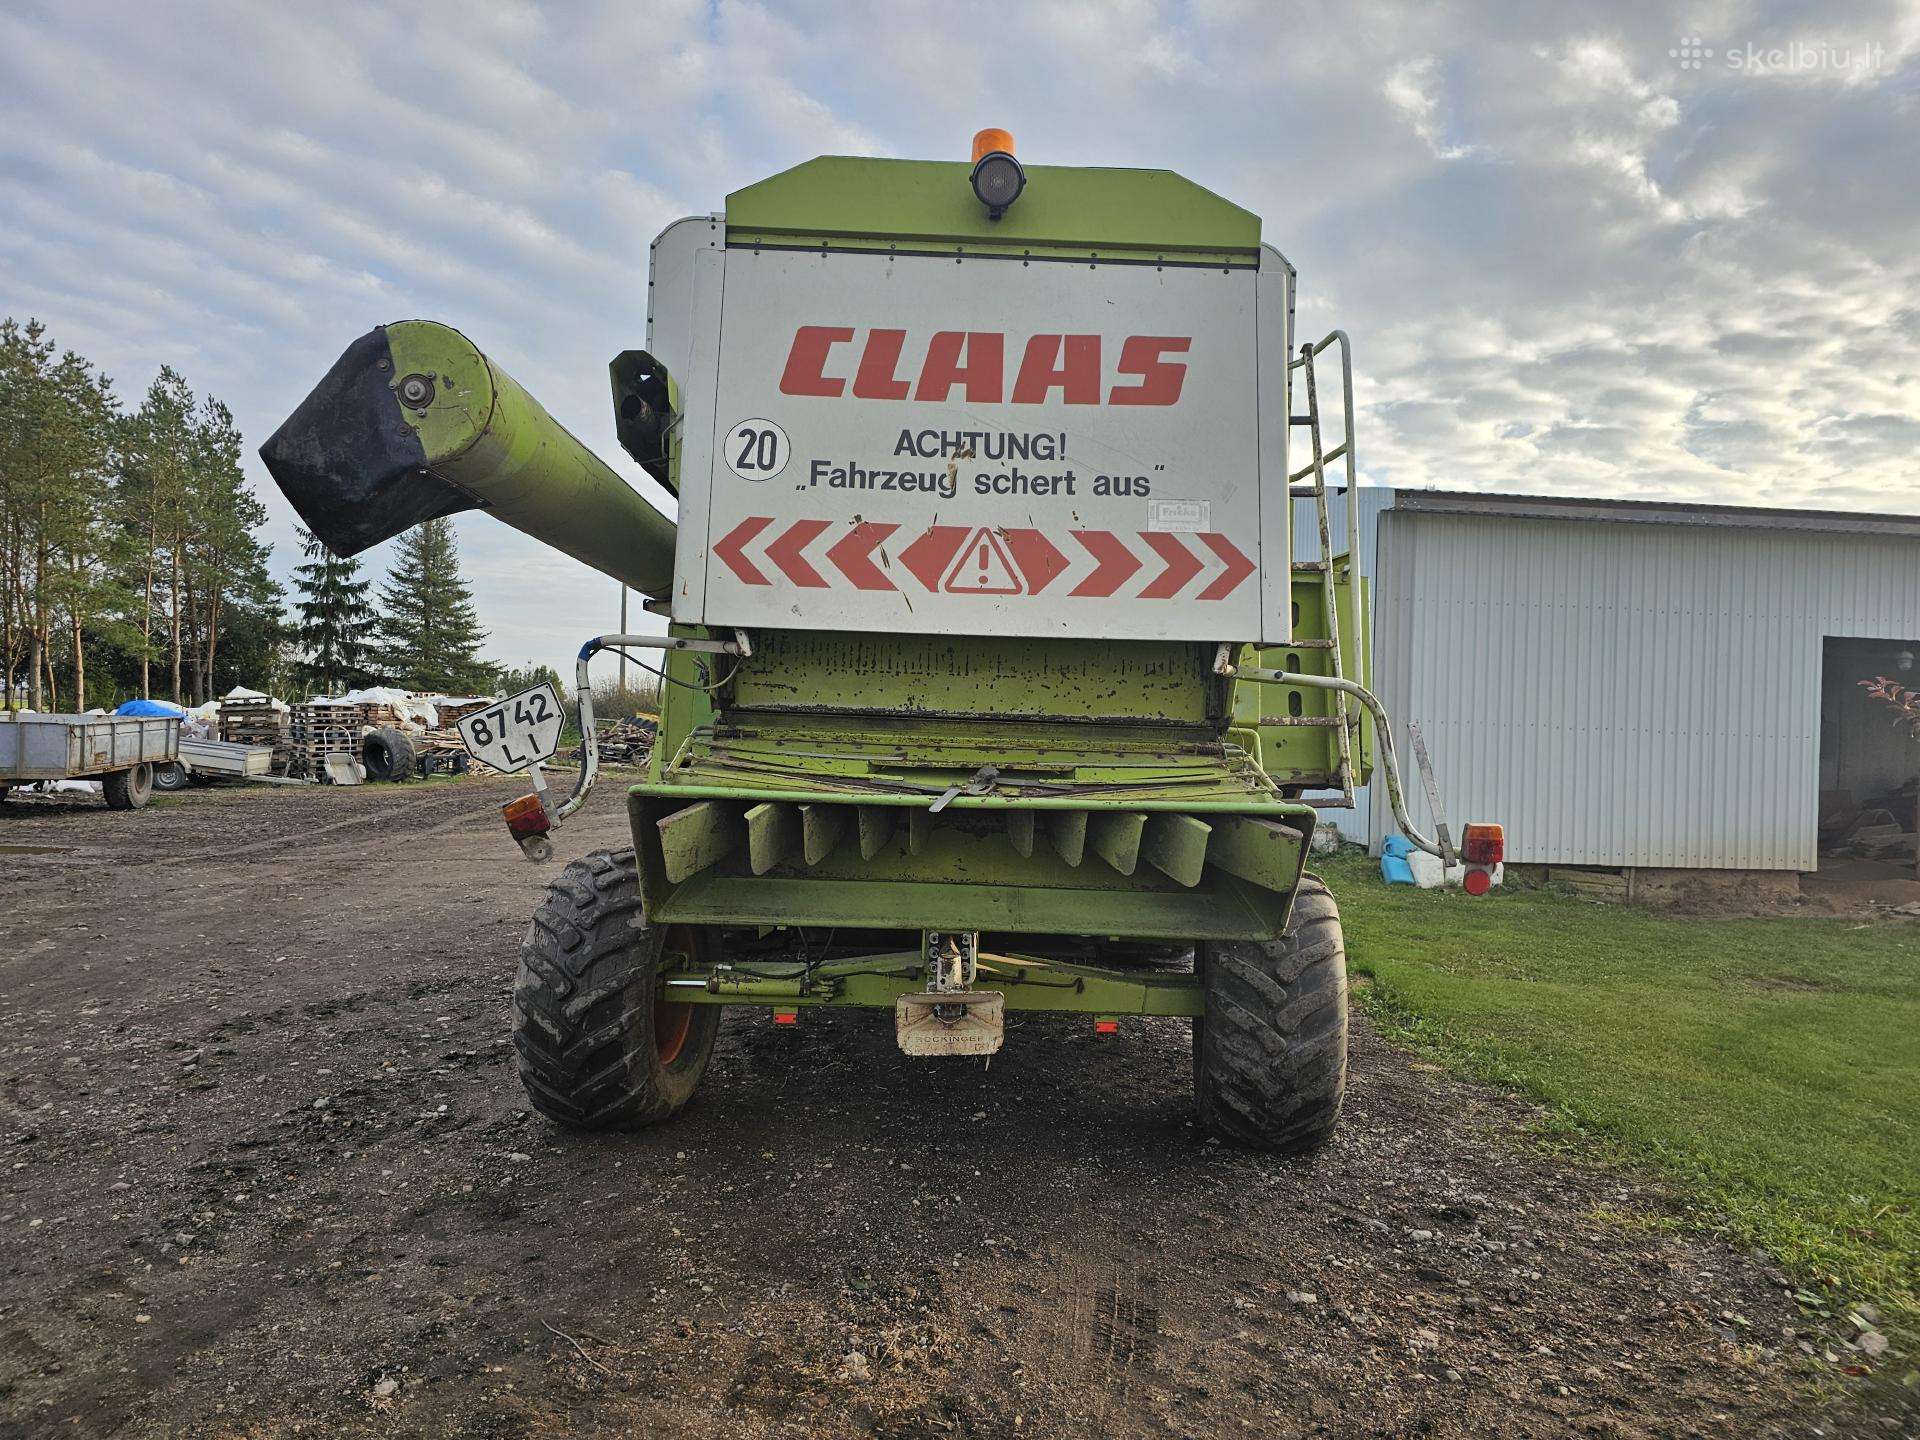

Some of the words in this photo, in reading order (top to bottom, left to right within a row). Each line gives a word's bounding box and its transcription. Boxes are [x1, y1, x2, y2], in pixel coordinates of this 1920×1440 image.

[779, 325, 1192, 406] CLAAS
[736, 428, 778, 471] 20
[893, 429, 1066, 461] ACHTUNG!
[974, 467, 1076, 495] schert
